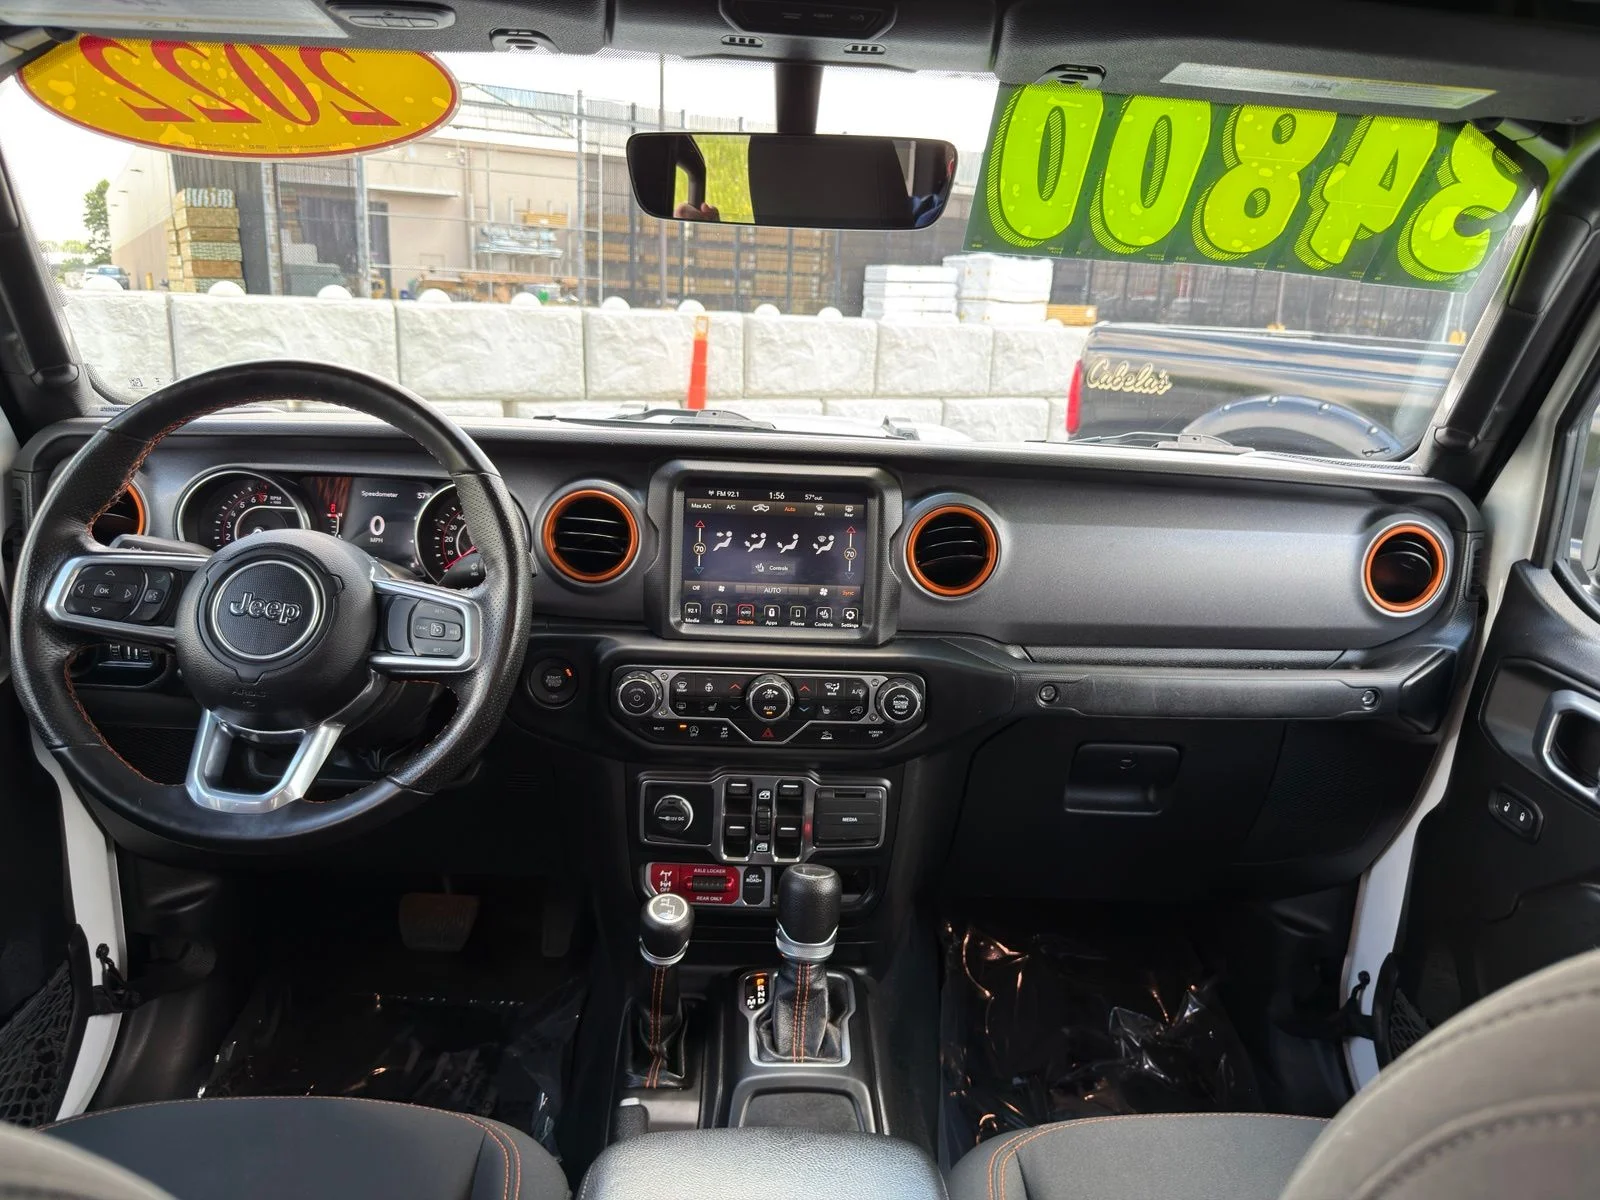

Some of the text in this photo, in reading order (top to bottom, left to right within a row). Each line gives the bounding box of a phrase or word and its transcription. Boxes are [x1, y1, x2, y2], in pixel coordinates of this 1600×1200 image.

[1087, 359, 1173, 395] Cabela's
[361, 490, 398, 498] Speedometer
[769, 491, 785, 500] 1:56
[251, 496, 257, 504] 6
[239, 501, 246, 509] 5
[370, 515, 386, 536] 0
[225, 533, 231, 541] 2
[695, 545, 704, 553] 70
[230, 592, 301, 625] Jeep
[756, 978, 765, 986] P
[757, 990, 766, 998] N
[746, 997, 757, 1006] M
[757, 997, 766, 1005] D
